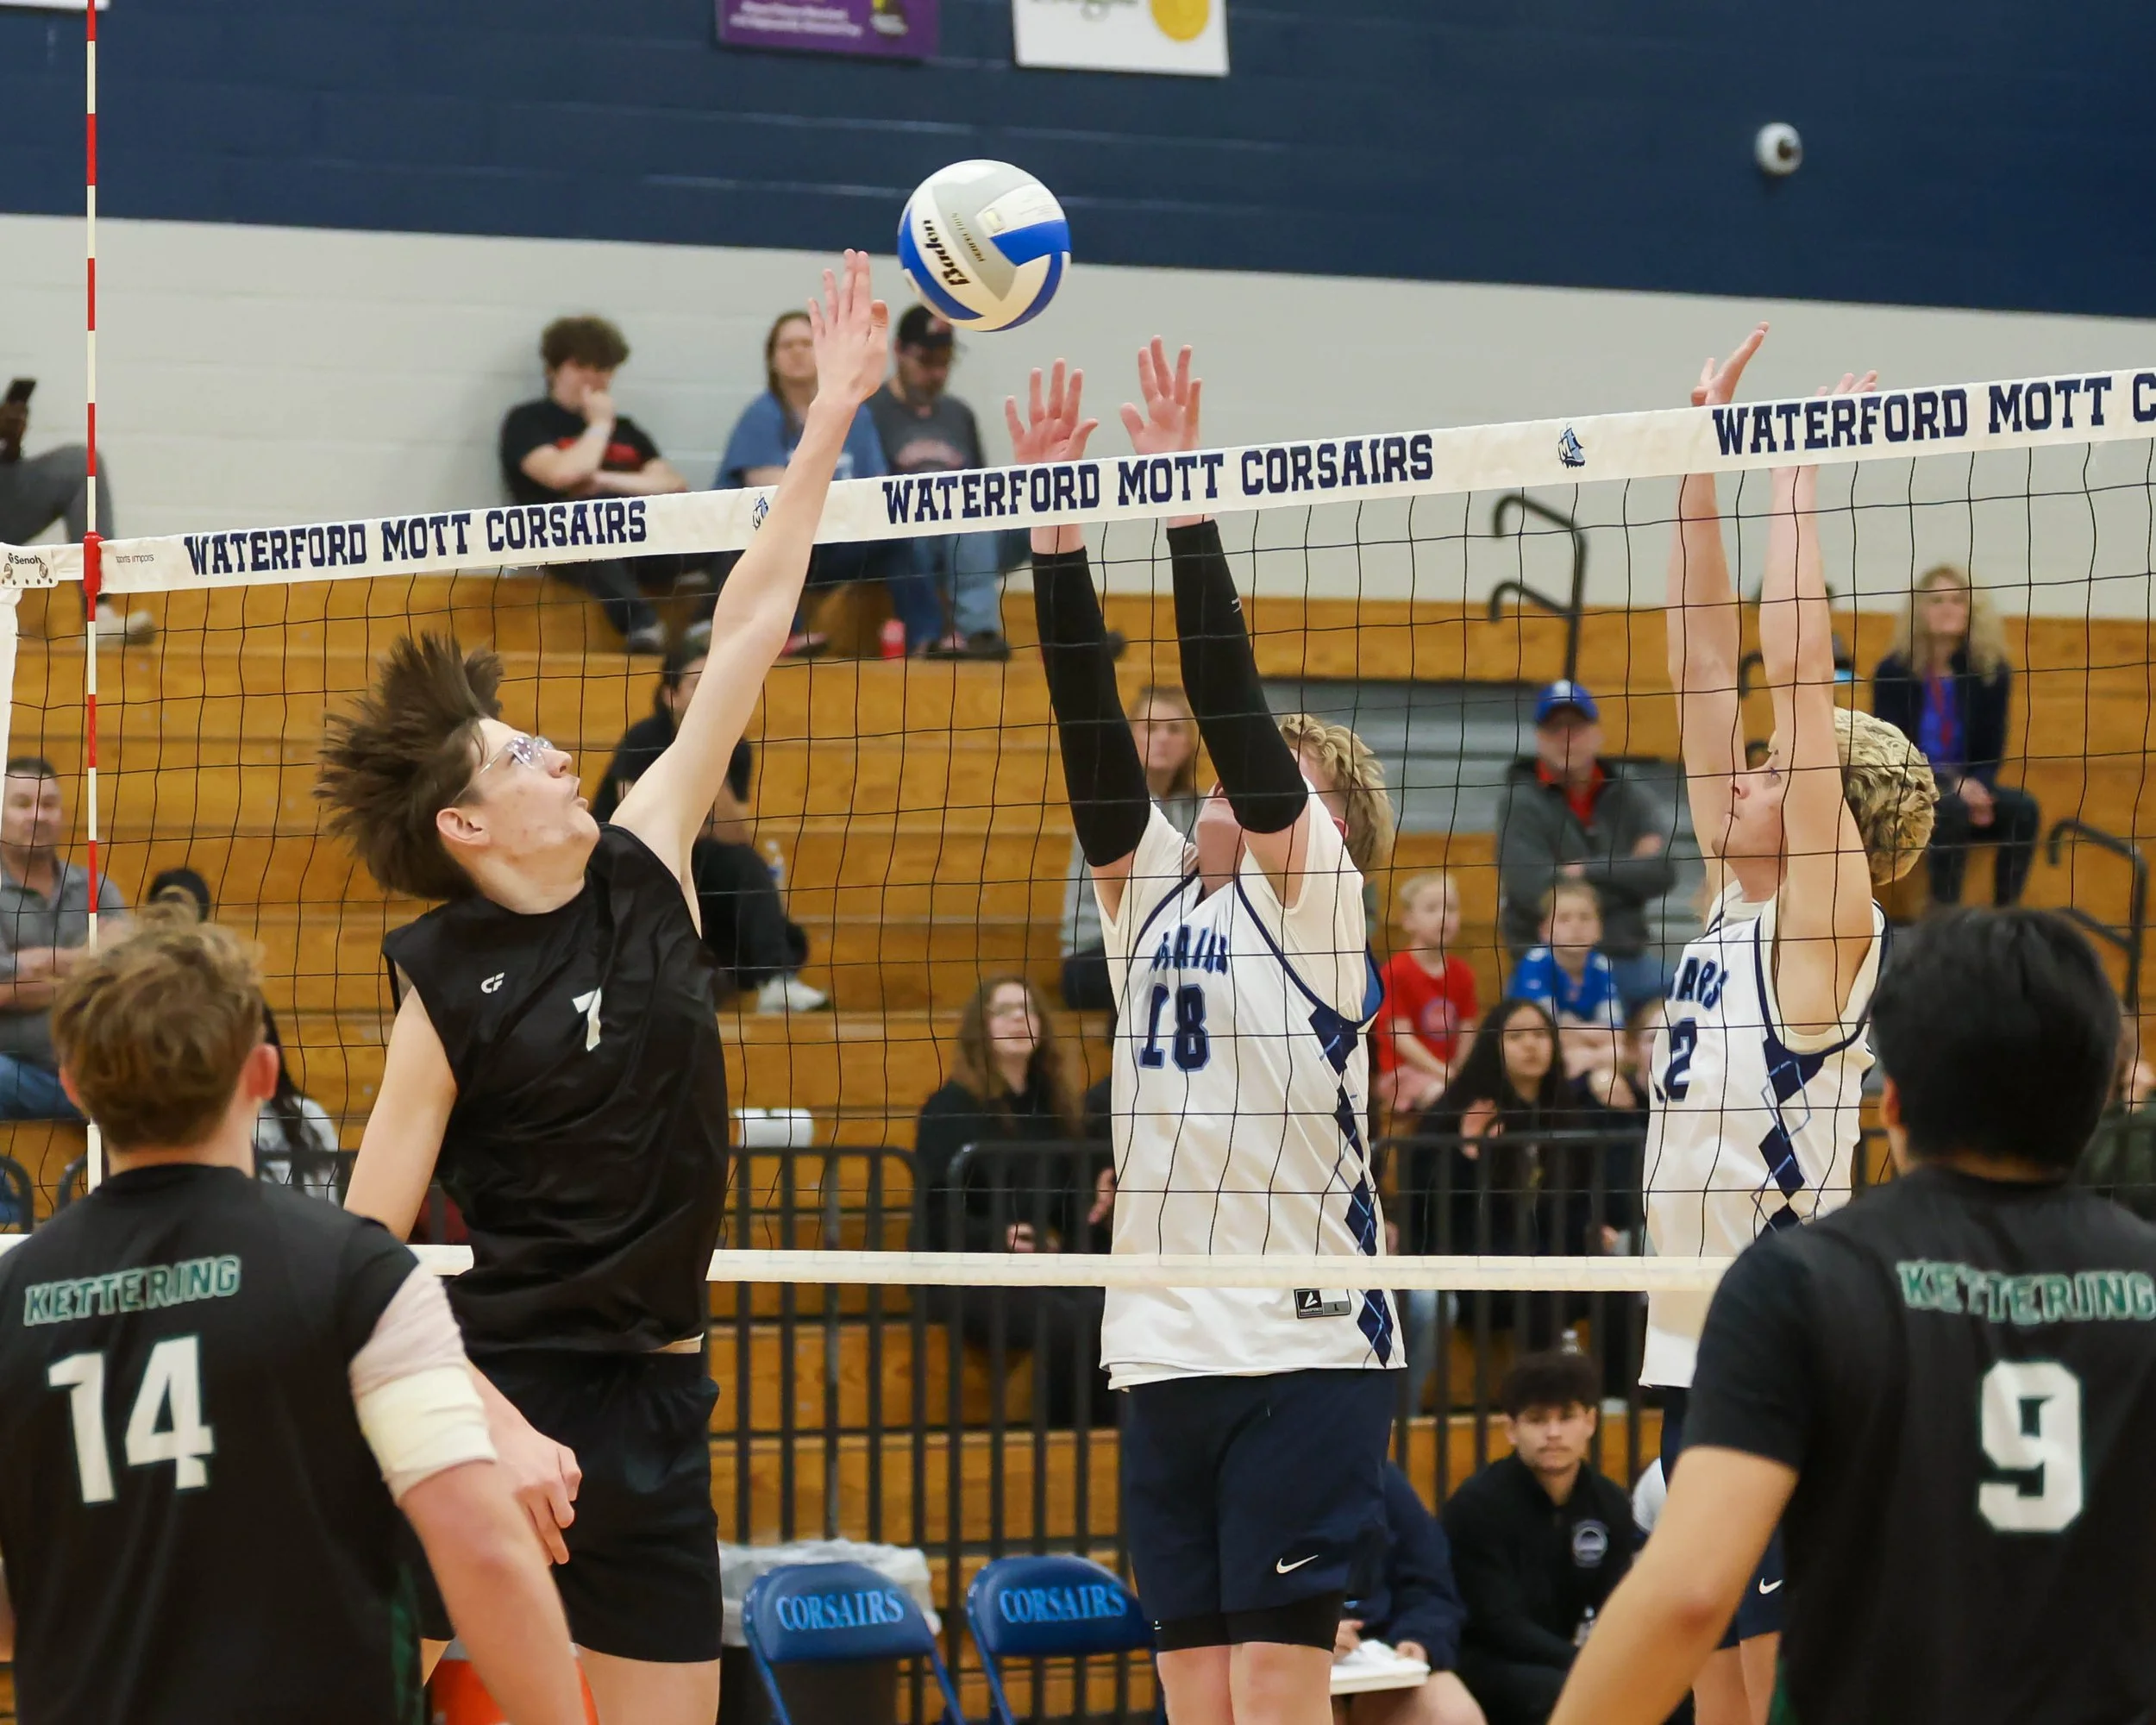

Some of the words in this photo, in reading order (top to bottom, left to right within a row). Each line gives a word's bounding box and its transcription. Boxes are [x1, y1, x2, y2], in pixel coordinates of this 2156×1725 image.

[923, 219, 971, 285] Baden
[1711, 389, 1968, 455] WATERFORD
[1988, 376, 2112, 434] MOTT
[2133, 373, 2156, 423] C
[882, 469, 1100, 524] WATERFORD
[1118, 453, 1224, 506] MOTT
[1241, 434, 1433, 496] CORSAIRS
[14, 555, 42, 565] Senoh
[184, 524, 367, 575] WATERFORD
[380, 514, 471, 561] MOTT
[486, 500, 647, 552] CORSAIRS
[1138, 982, 1211, 1072] 18
[23, 1255, 241, 1327] KETTERING
[1896, 1258, 2156, 1325] KETTERING
[47, 1334, 216, 1504] 14
[1977, 1358, 2084, 1532] 9
[775, 1589, 905, 1631] CORSAIRS
[999, 1583, 1127, 1623] CORSAIRS
